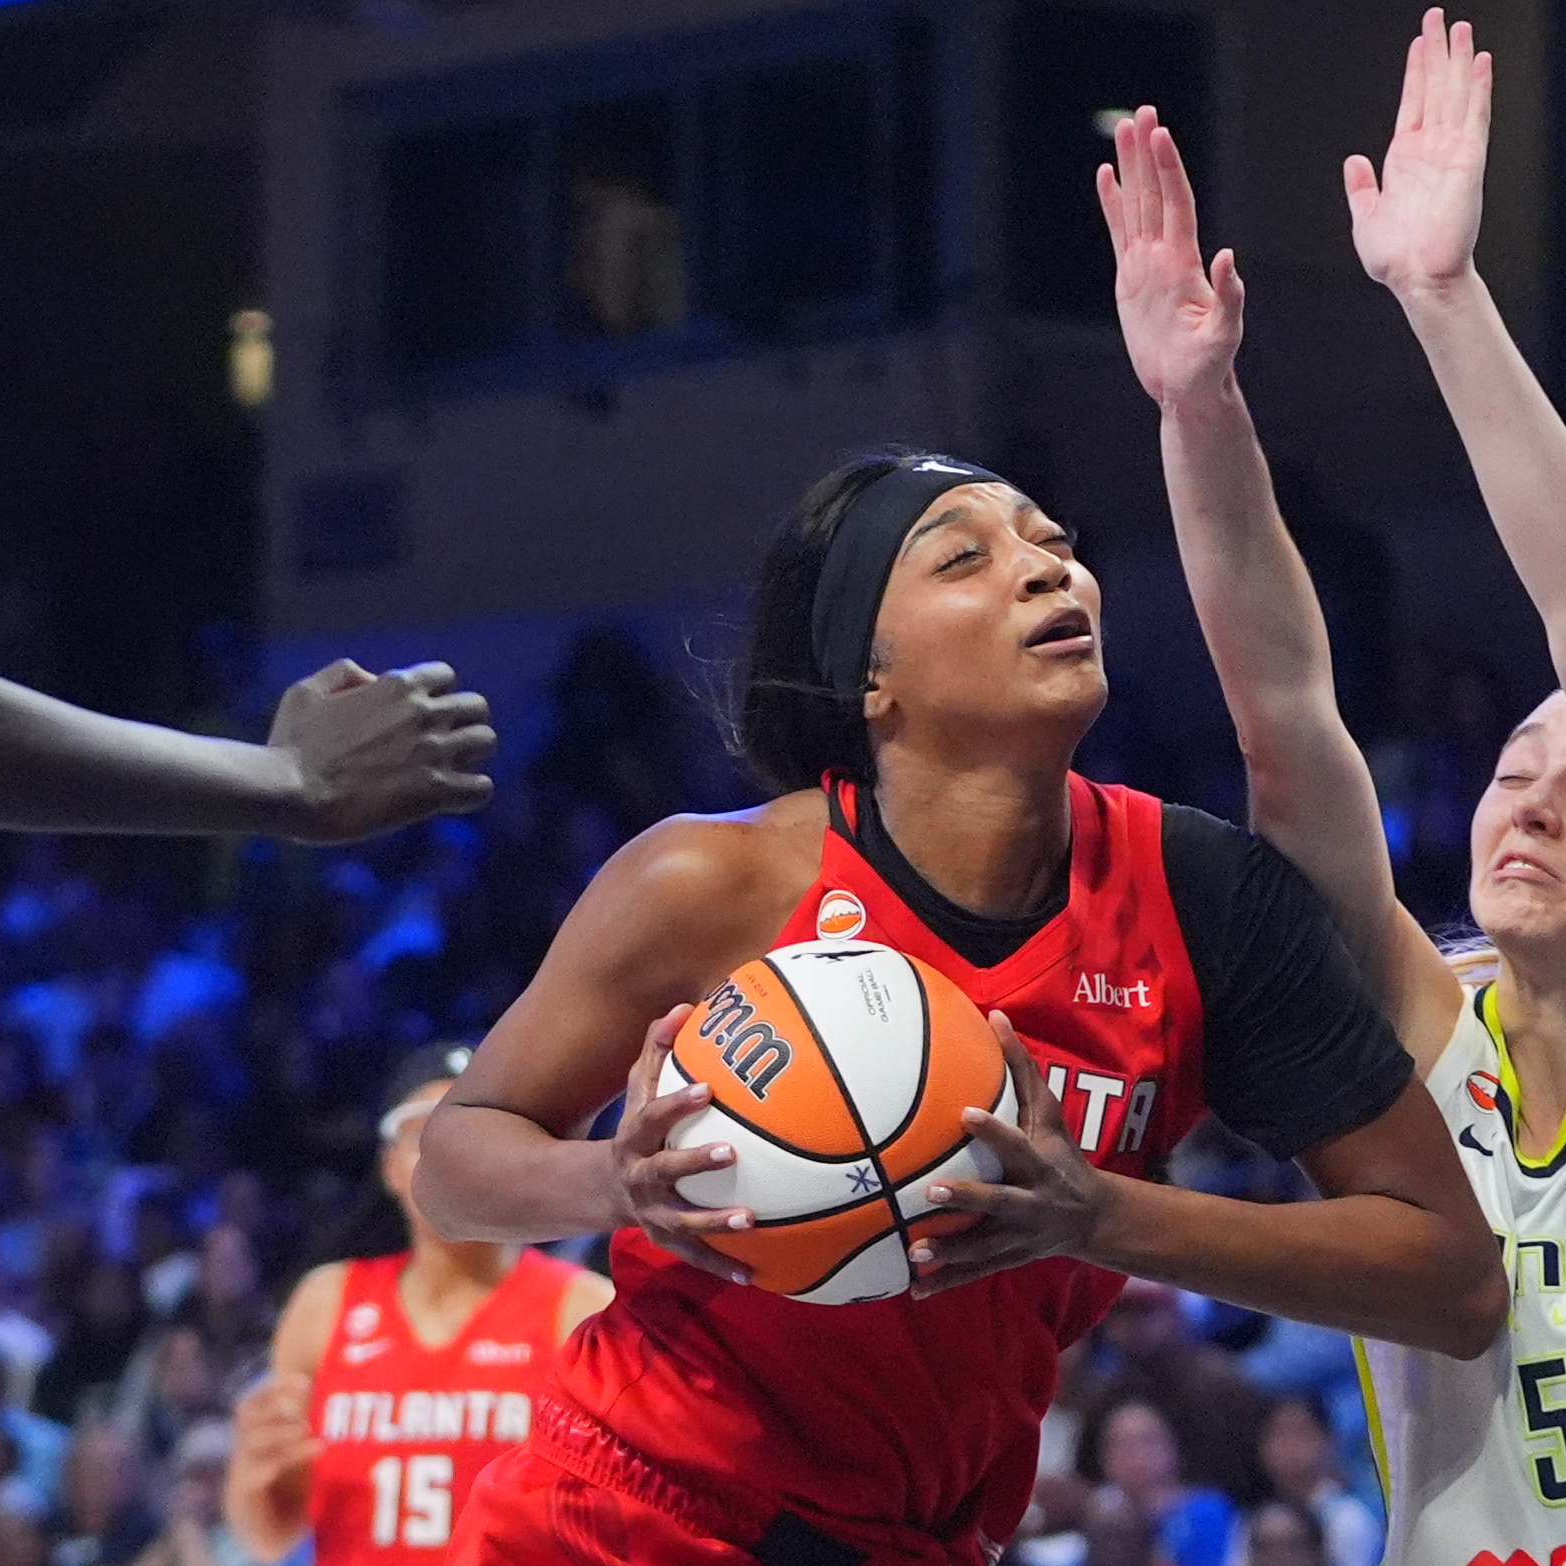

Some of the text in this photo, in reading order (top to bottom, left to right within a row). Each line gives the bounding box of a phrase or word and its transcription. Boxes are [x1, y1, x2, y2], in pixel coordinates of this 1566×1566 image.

[858, 972, 876, 1016] OFFICIAL
[1073, 971, 1152, 1008] Albert
[699, 976, 793, 1102] Wils
[322, 1390, 532, 1443] ATLANTA
[371, 1454, 455, 1546] 15
